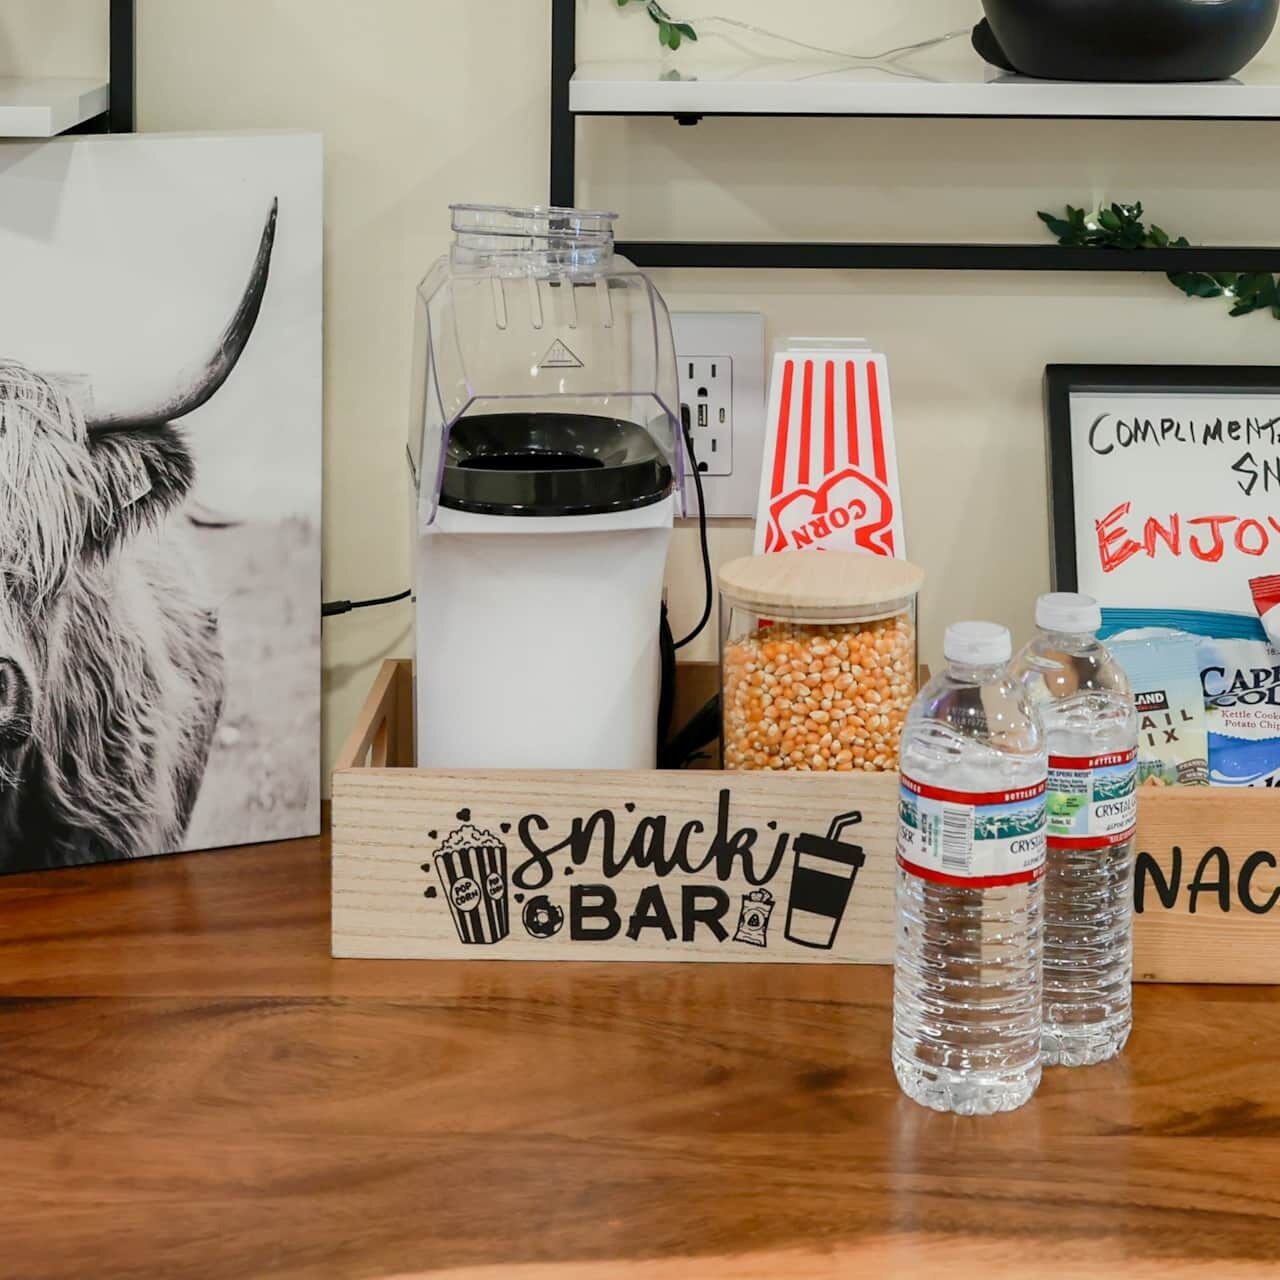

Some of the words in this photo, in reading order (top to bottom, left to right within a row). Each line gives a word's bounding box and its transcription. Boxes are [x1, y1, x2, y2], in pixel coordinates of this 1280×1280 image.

[790, 498, 867, 550] CORN
[1141, 709, 1193, 730] AIL
[1221, 709, 1251, 719] Kettle
[1225, 719, 1257, 729] Potato
[1147, 728, 1180, 747] IX
[512, 789, 790, 890] snack
[570, 884, 730, 942] BAR
